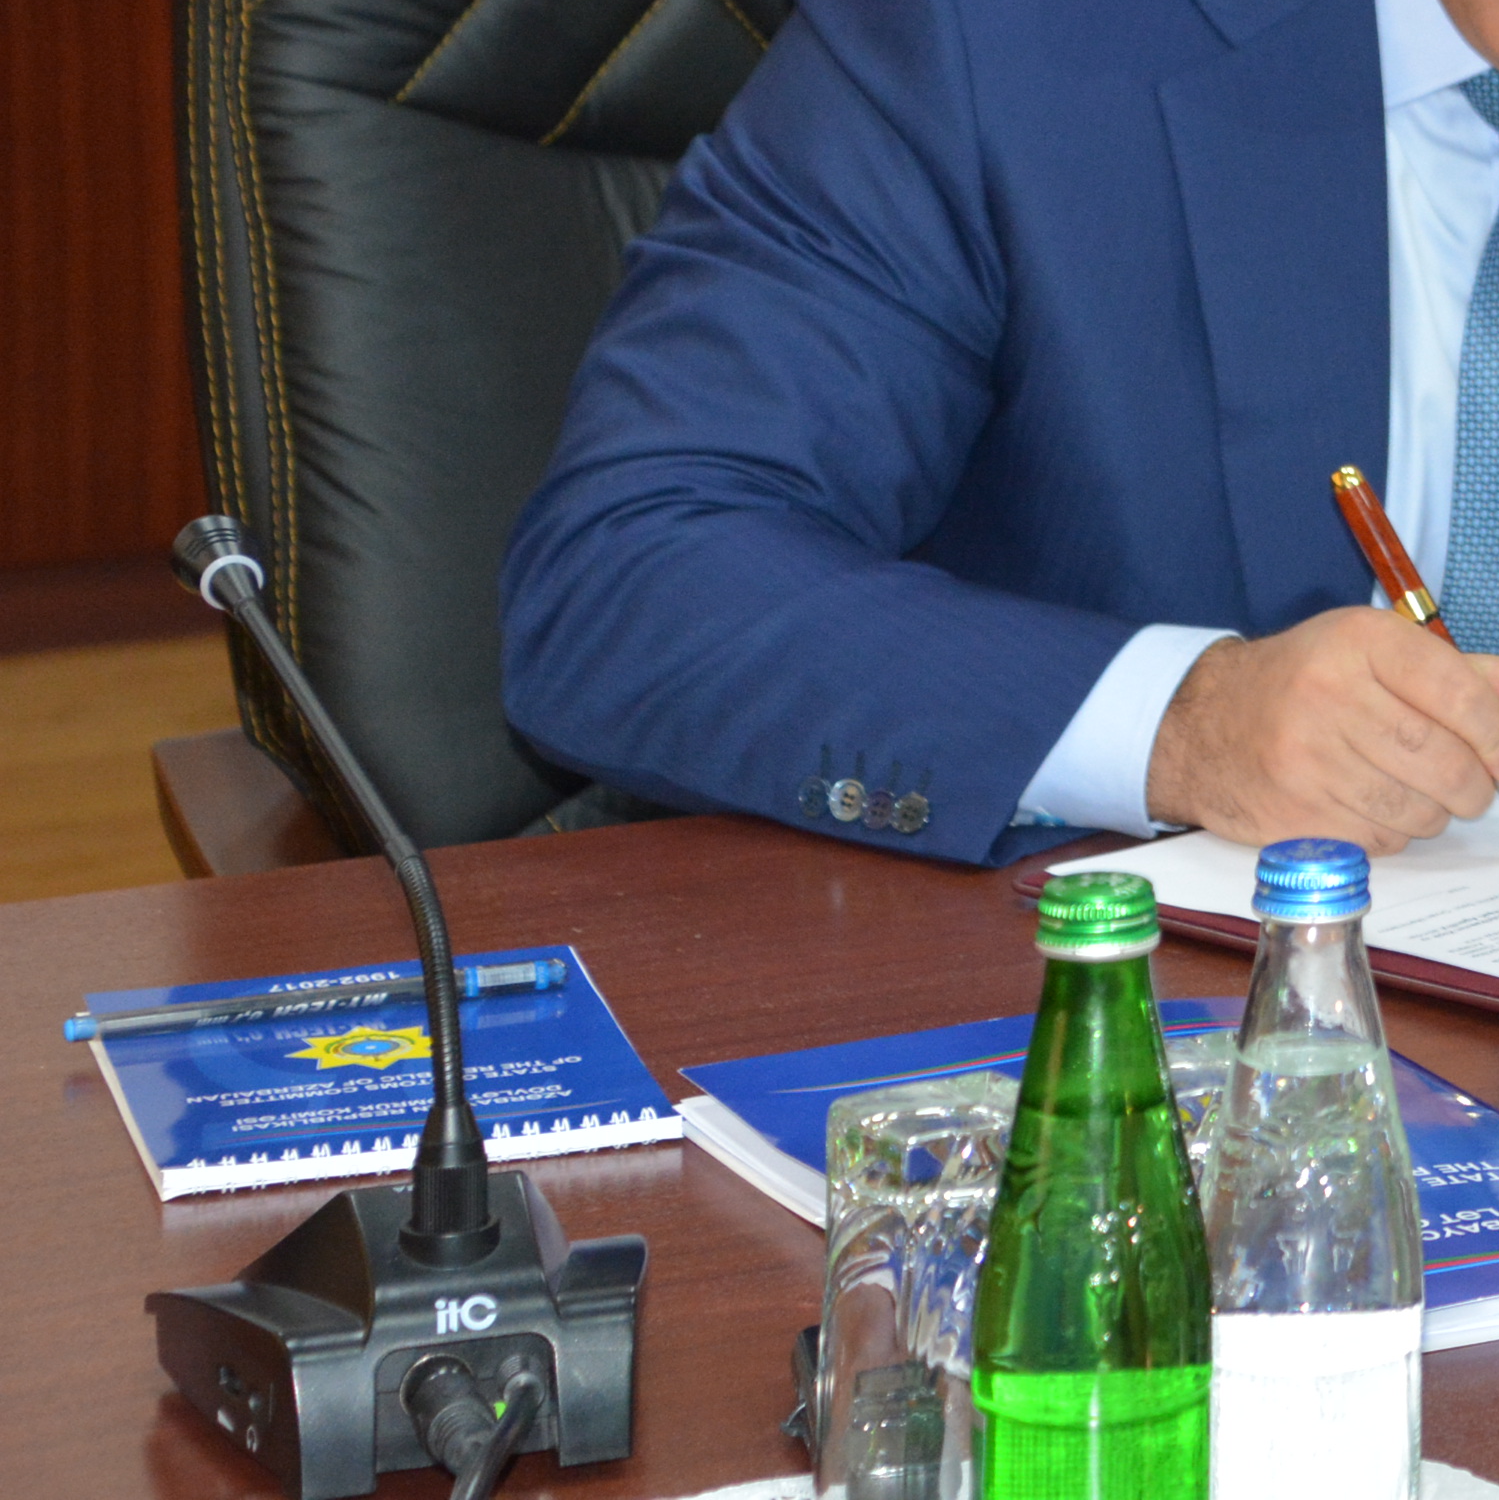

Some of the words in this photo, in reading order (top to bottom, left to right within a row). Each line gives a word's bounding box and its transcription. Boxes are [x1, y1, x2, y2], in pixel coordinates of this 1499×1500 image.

[268, 970, 402, 994] 1992-2017
[501, 1059, 547, 1070] THE
[552, 1055, 582, 1065] OF
[379, 1065, 495, 1083] REBLIC
[485, 1064, 558, 1079] STATE
[343, 1077, 374, 1087] OF
[364, 1073, 478, 1090] CTOMS
[187, 1081, 335, 1105] AZERBAIJAN
[219, 1085, 359, 1107] COMMITTEE
